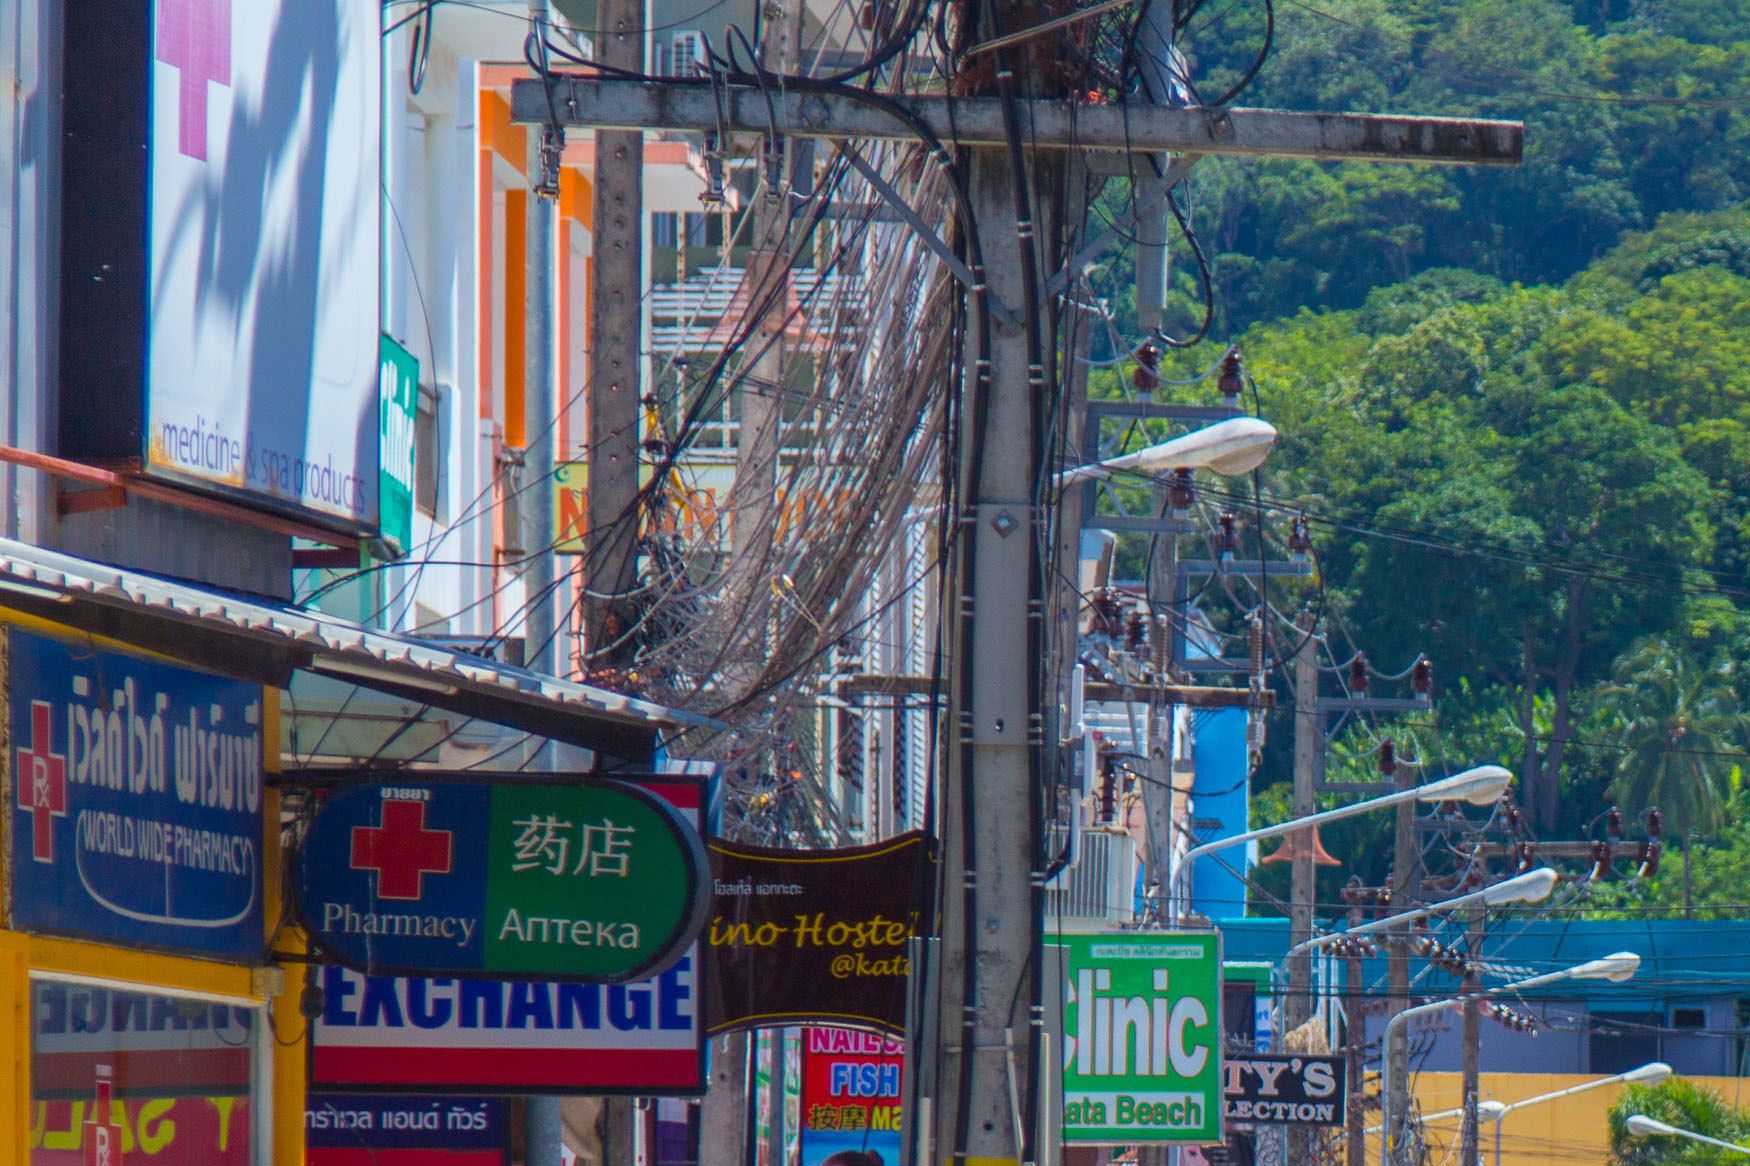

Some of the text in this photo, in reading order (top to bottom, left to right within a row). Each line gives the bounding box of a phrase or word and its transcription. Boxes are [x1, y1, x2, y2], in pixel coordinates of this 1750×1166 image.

[161, 414, 241, 474] medicine
[261, 447, 289, 497] spa
[294, 453, 366, 514] products
[82, 809, 250, 876] WORLD WIDE PHARMACY
[512, 813, 637, 877] 药店
[323, 902, 478, 948] Pharmacy
[499, 908, 641, 950] Аптека
[322, 956, 693, 1032] EXCHANGE
[831, 1062, 900, 1097] FISH
[382, 1102, 440, 1130] แอนด์
[447, 1102, 488, 1130] ทัวร์
[808, 1102, 868, 1131] 按摩
[1116, 1095, 1202, 1126] Beach
